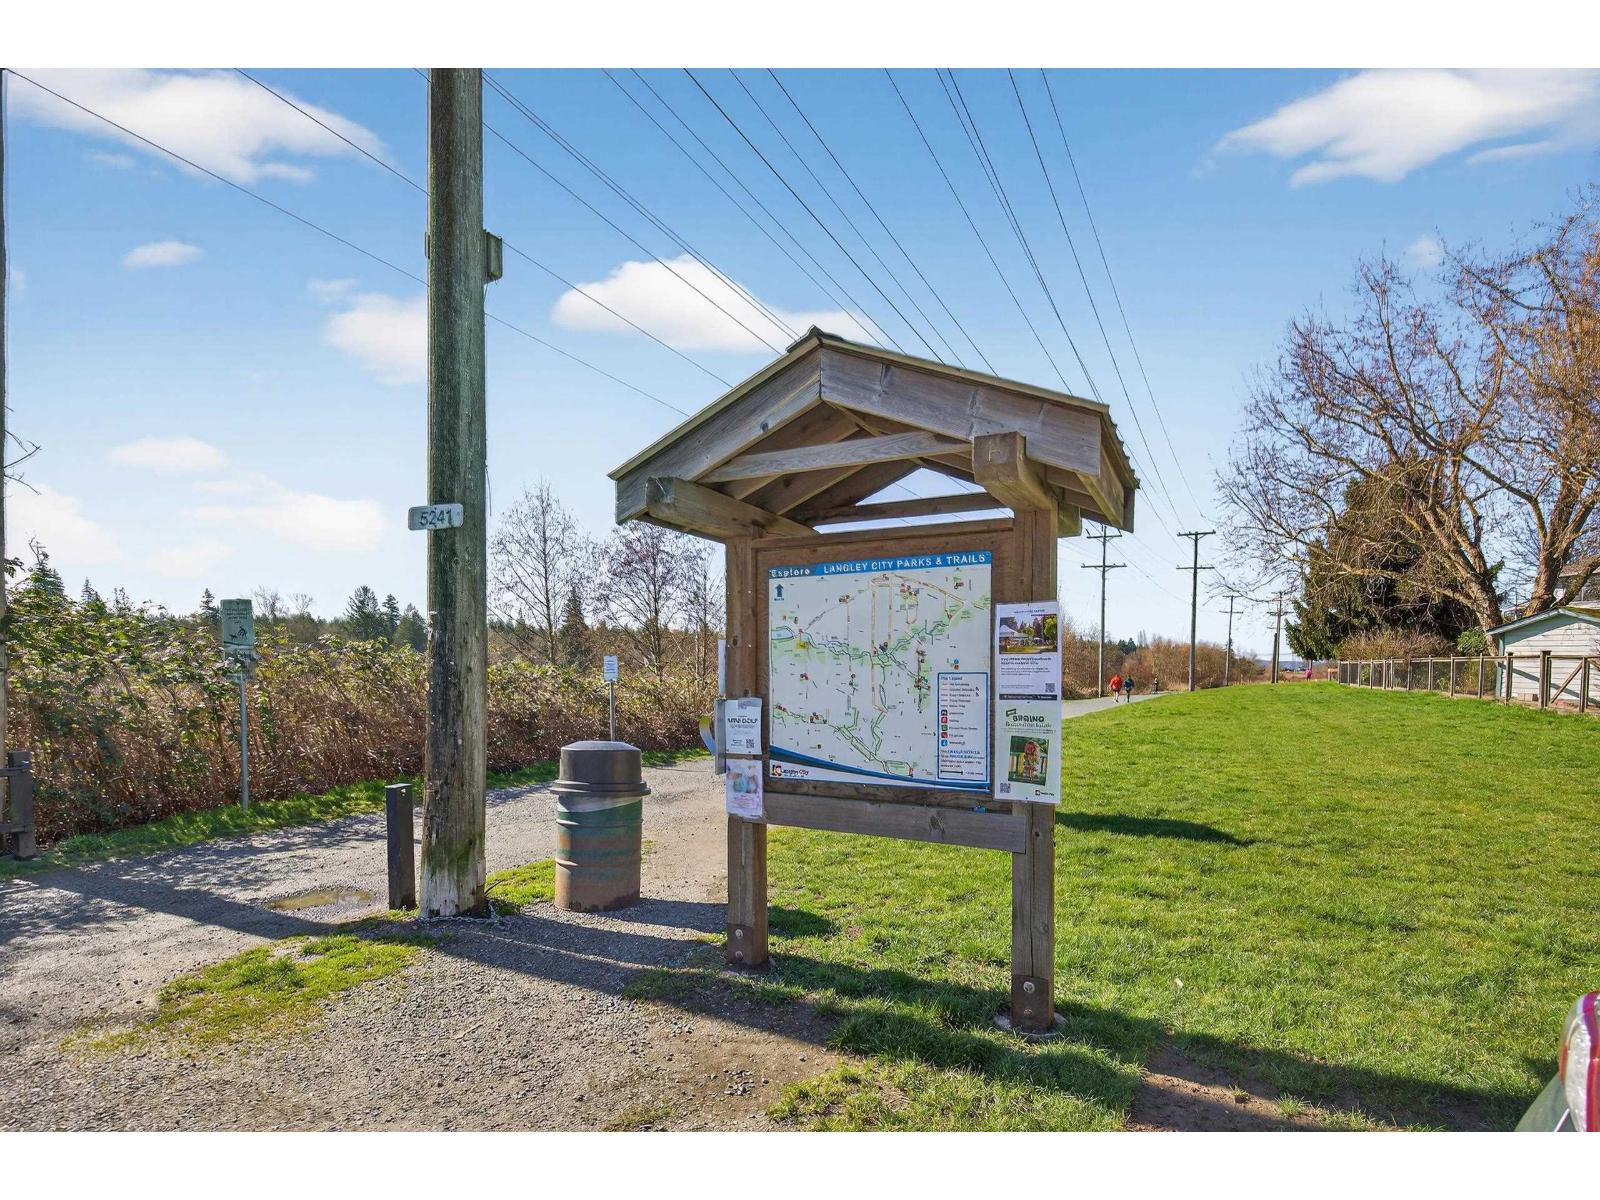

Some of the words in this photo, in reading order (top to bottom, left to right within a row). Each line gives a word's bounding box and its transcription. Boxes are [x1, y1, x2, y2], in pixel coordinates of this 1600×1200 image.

[419, 508, 452, 526] 5241
[823, 562, 868, 574] LANGLEY
[871, 560, 894, 570] CITY
[896, 557, 932, 568] PARKS
[935, 557, 942, 565] &
[946, 554, 985, 565] TRAILS
